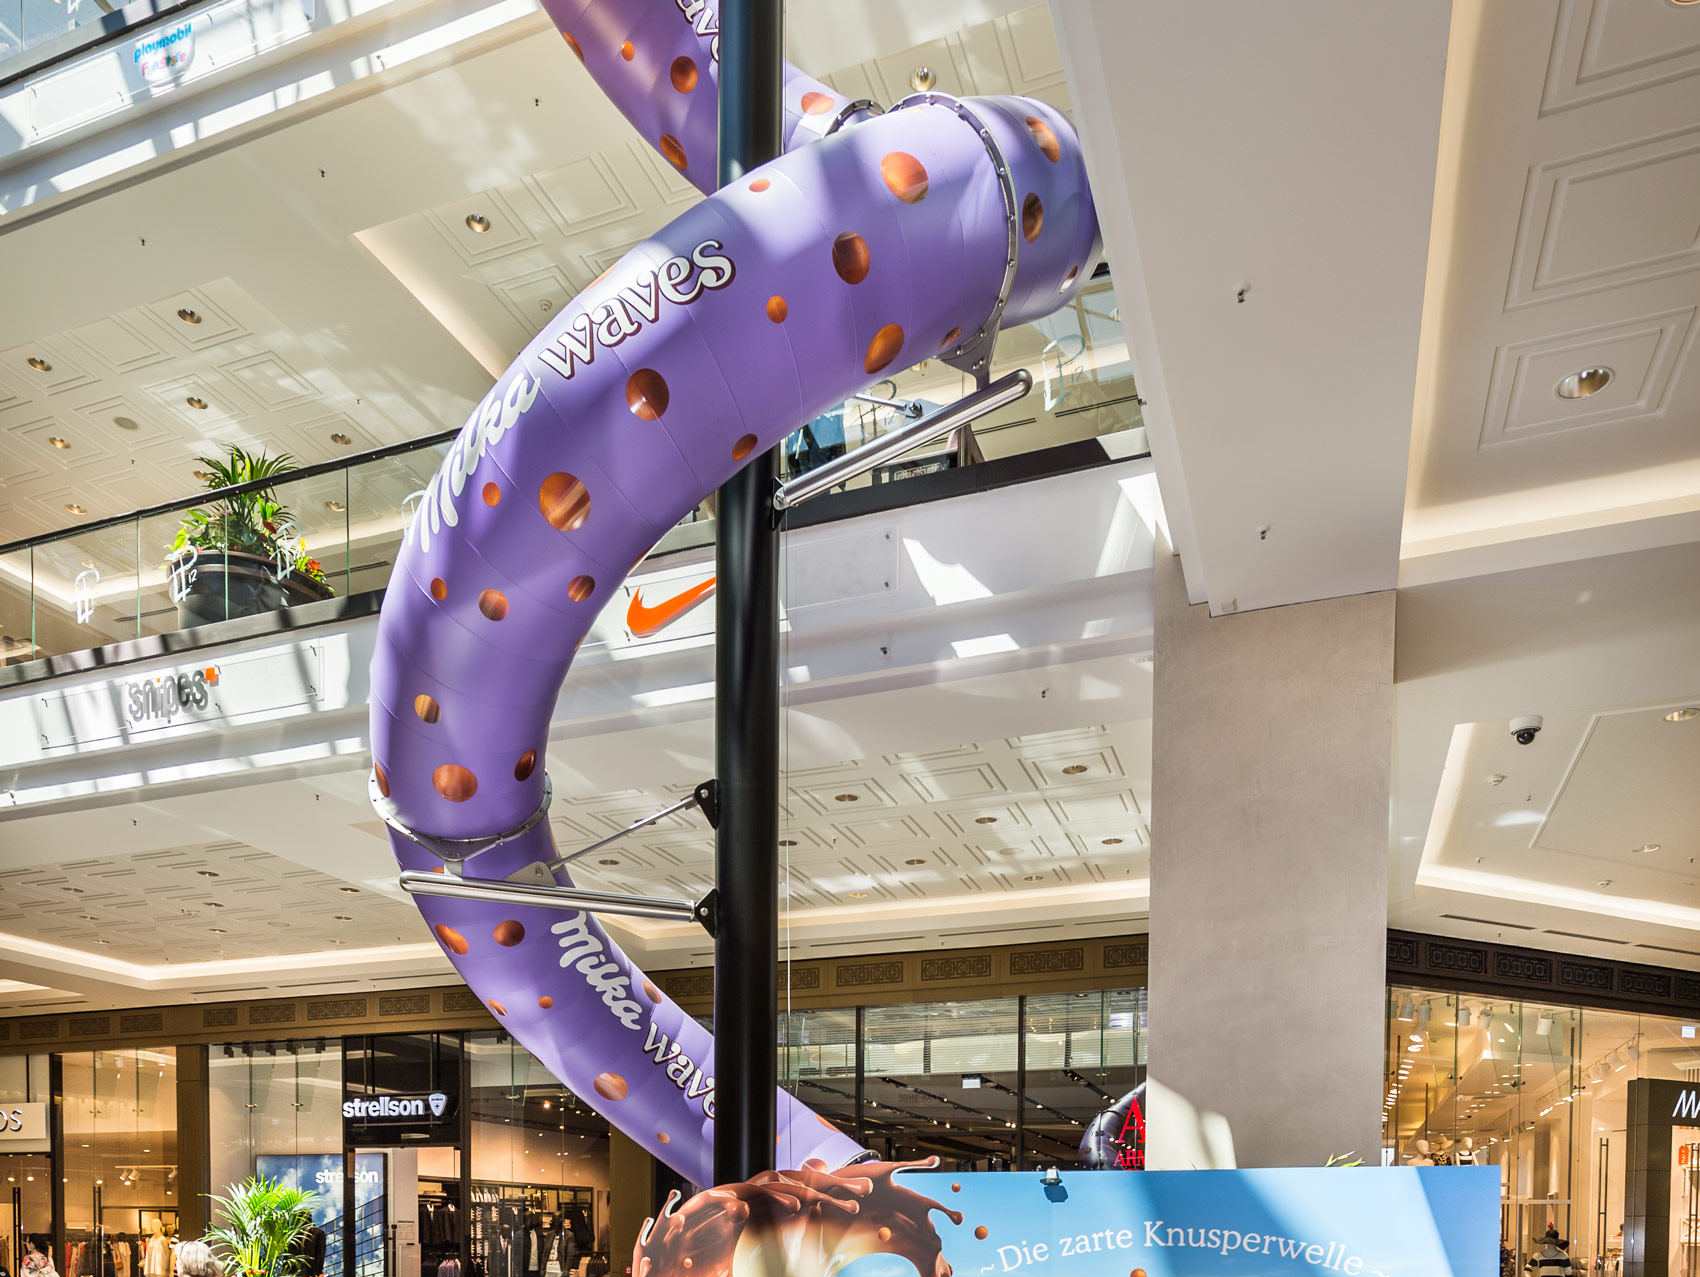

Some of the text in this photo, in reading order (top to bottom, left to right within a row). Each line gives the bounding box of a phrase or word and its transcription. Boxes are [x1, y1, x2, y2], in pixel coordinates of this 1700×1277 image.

[134, 23, 192, 64] playmobil
[407, 239, 736, 553] Milka waves
[128, 669, 209, 724] snipes
[550, 910, 643, 1031] Milka
[342, 1096, 425, 1118] strellson
[315, 1168, 379, 1184] streson
[996, 1220, 1364, 1277] Die zarte Knusperwelle
